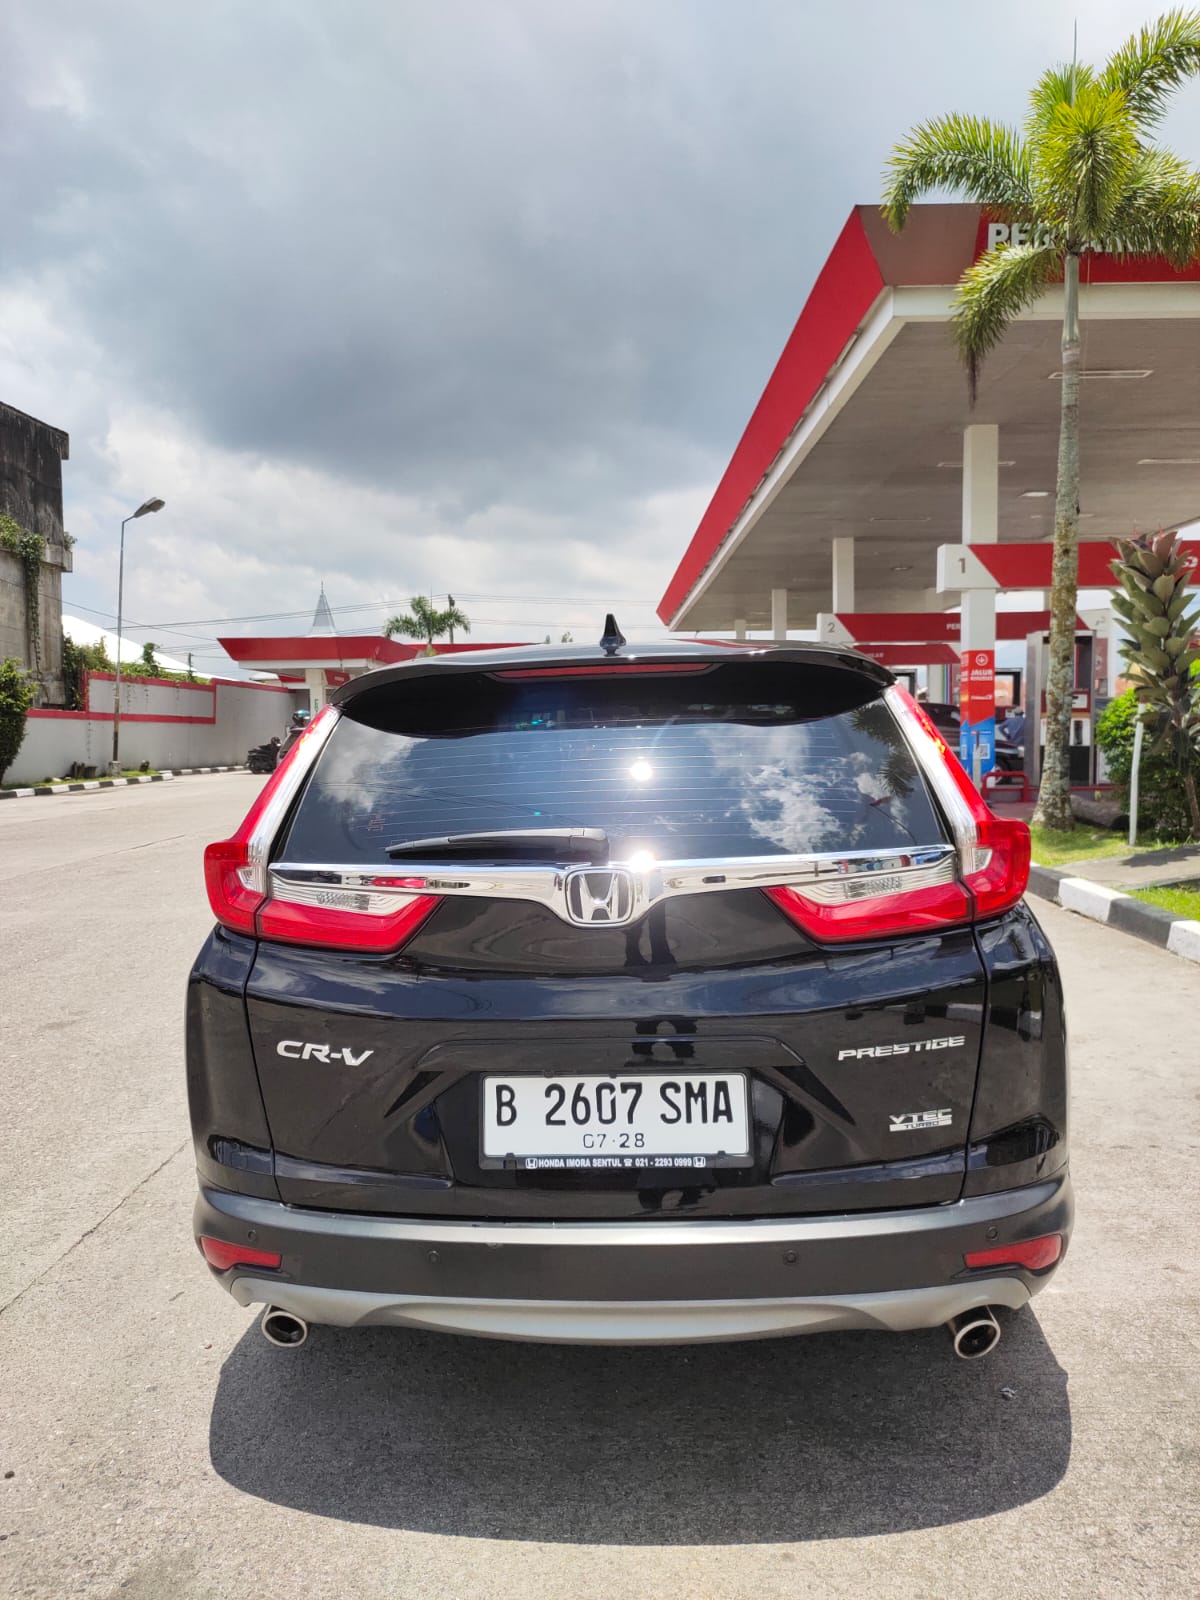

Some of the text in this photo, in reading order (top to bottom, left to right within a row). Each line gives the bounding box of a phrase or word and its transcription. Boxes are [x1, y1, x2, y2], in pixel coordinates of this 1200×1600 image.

[958, 557, 966, 574] 1
[827, 622, 836, 633] 2
[276, 1040, 374, 1066] CR-V
[837, 1035, 966, 1061] PRESTIGE
[495, 1081, 733, 1127] B 2607 SMA
[889, 1108, 953, 1124] VTEC
[905, 1121, 940, 1130] TURBO
[538, 1158, 565, 1168] HONDA
[566, 1158, 591, 1168] IMORA
[592, 1158, 622, 1168] SENTUL
[635, 1157, 649, 1167] 021
